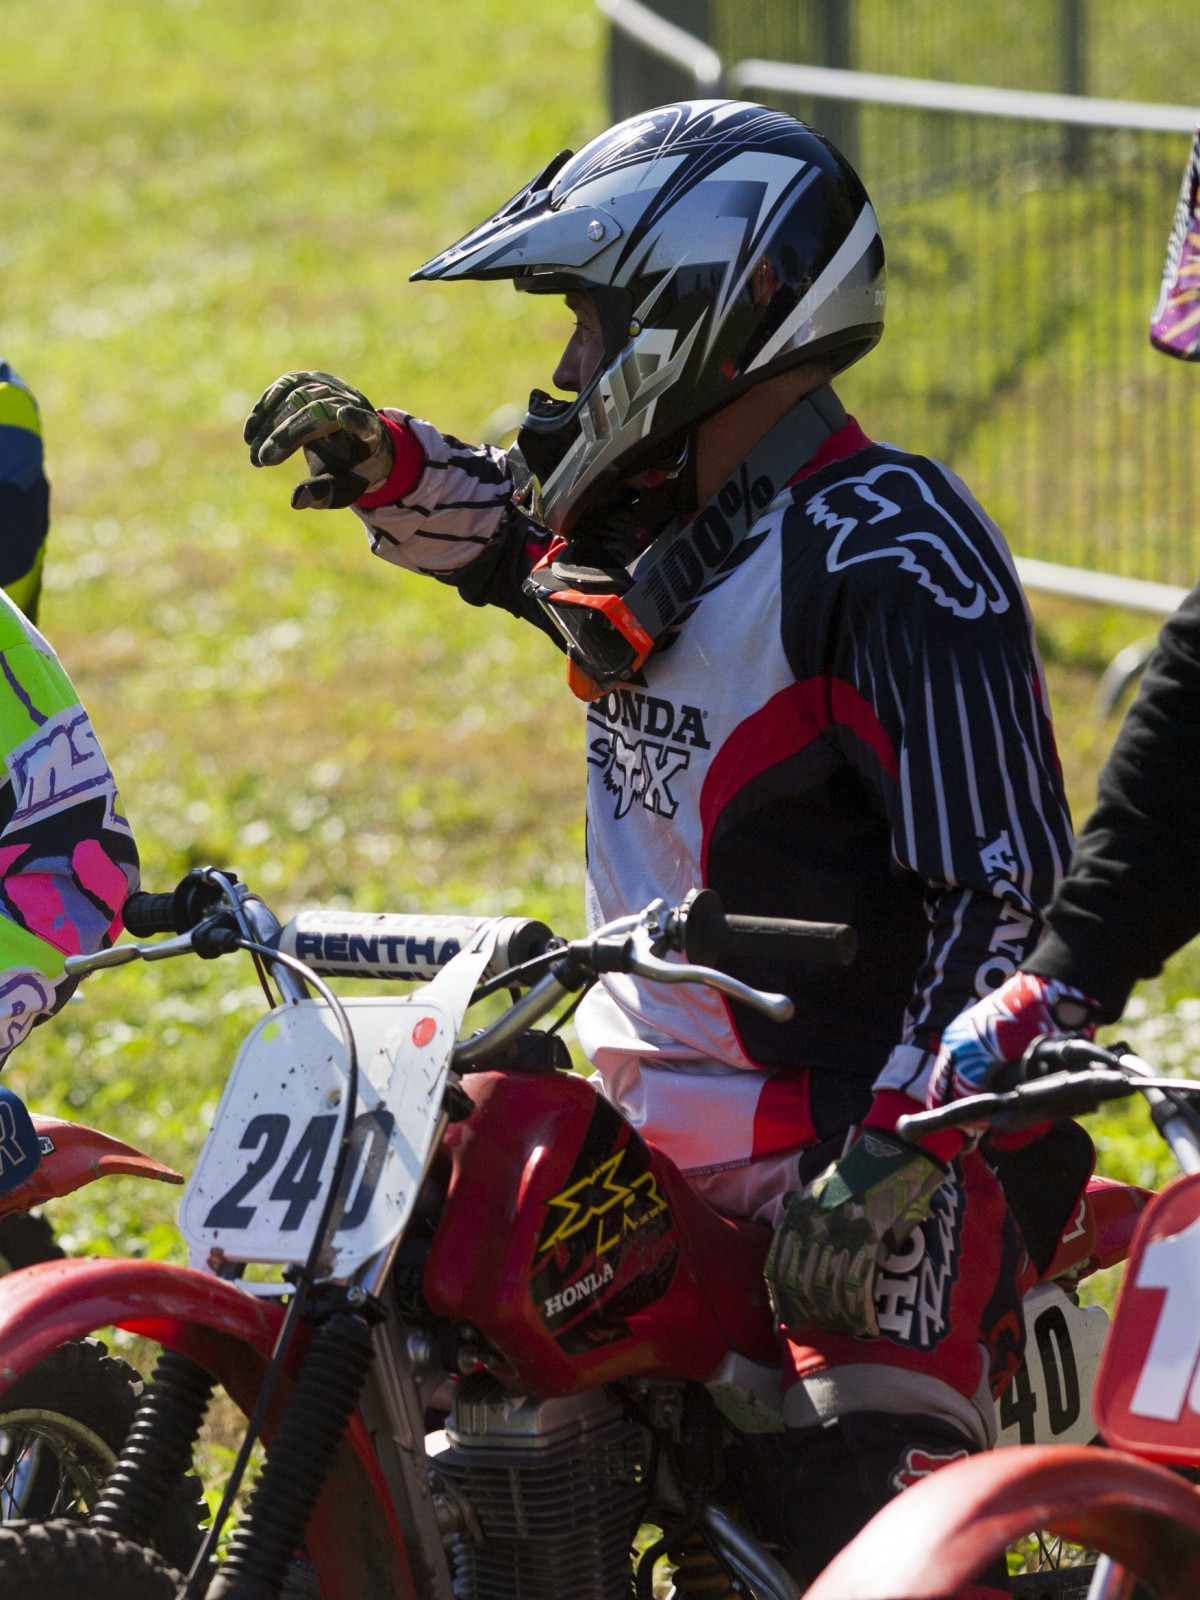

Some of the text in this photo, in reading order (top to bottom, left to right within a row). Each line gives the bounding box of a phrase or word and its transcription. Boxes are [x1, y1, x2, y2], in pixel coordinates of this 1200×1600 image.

[642, 462, 776, 627] 100%
[295, 931, 462, 966] RENTHA
[963, 829, 1034, 1003] ONDA
[203, 1110, 396, 1231] 240
[1129, 1214, 1200, 1423] 1
